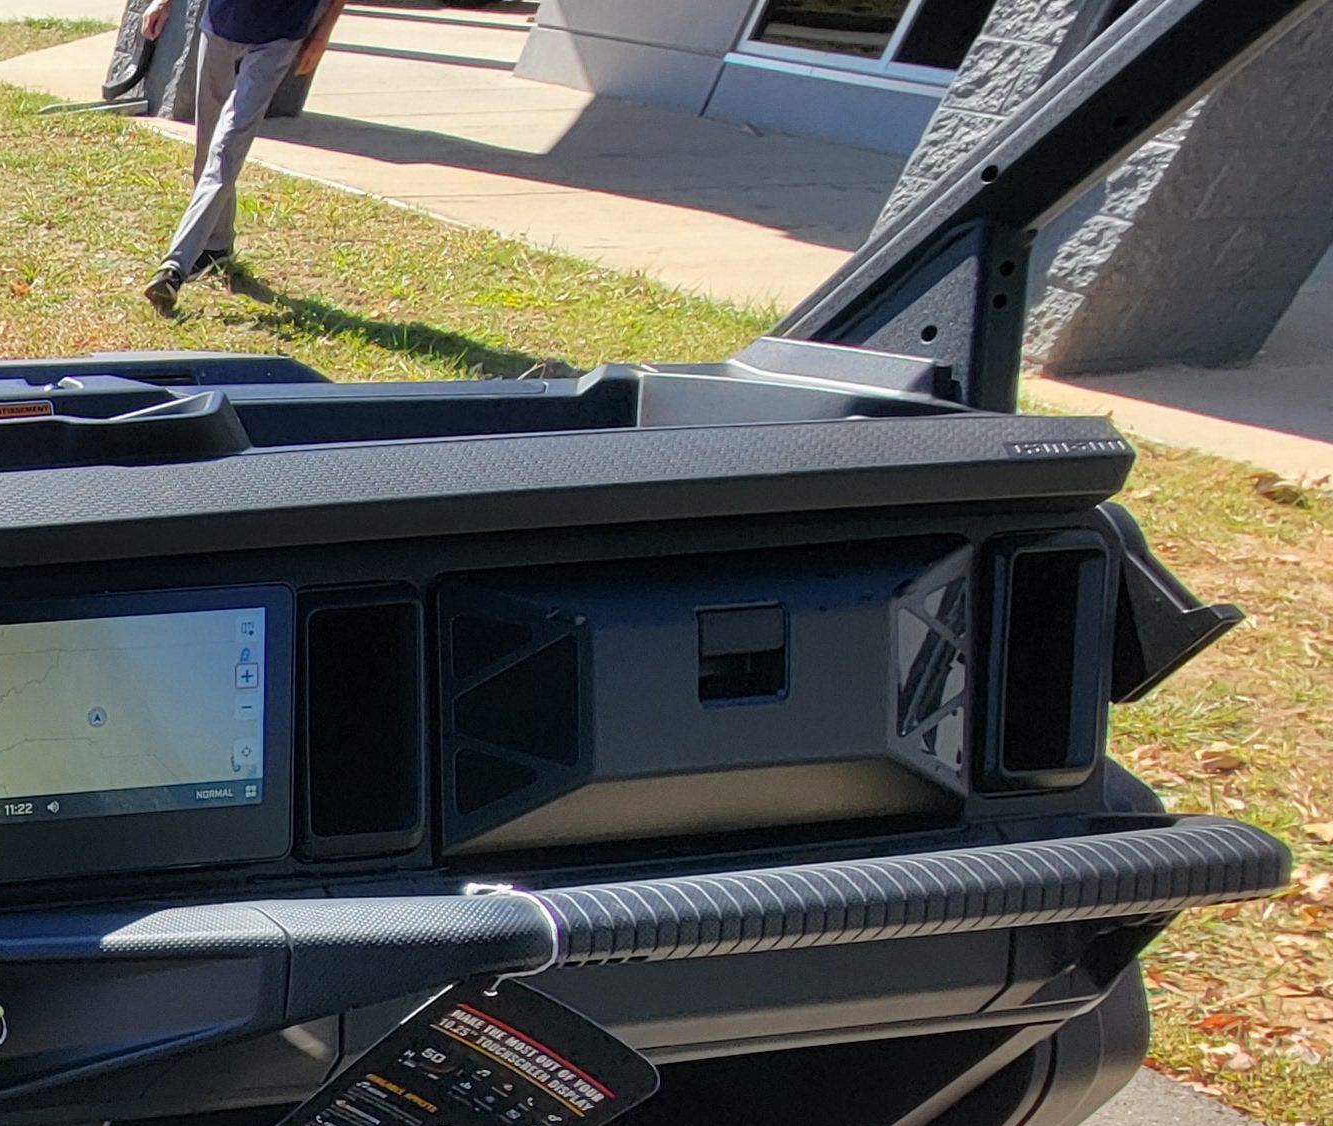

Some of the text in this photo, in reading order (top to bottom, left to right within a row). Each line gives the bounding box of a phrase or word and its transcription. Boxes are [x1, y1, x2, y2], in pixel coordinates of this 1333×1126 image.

[4, 802, 33, 816] 11:22
[196, 787, 234, 801] NORMAL
[450, 1009, 605, 1103] MAKE THE MOST OUT OF YOUR
[475, 1035, 551, 1083] TOUCHSCREEN
[547, 1079, 595, 1112] DISPLAY
